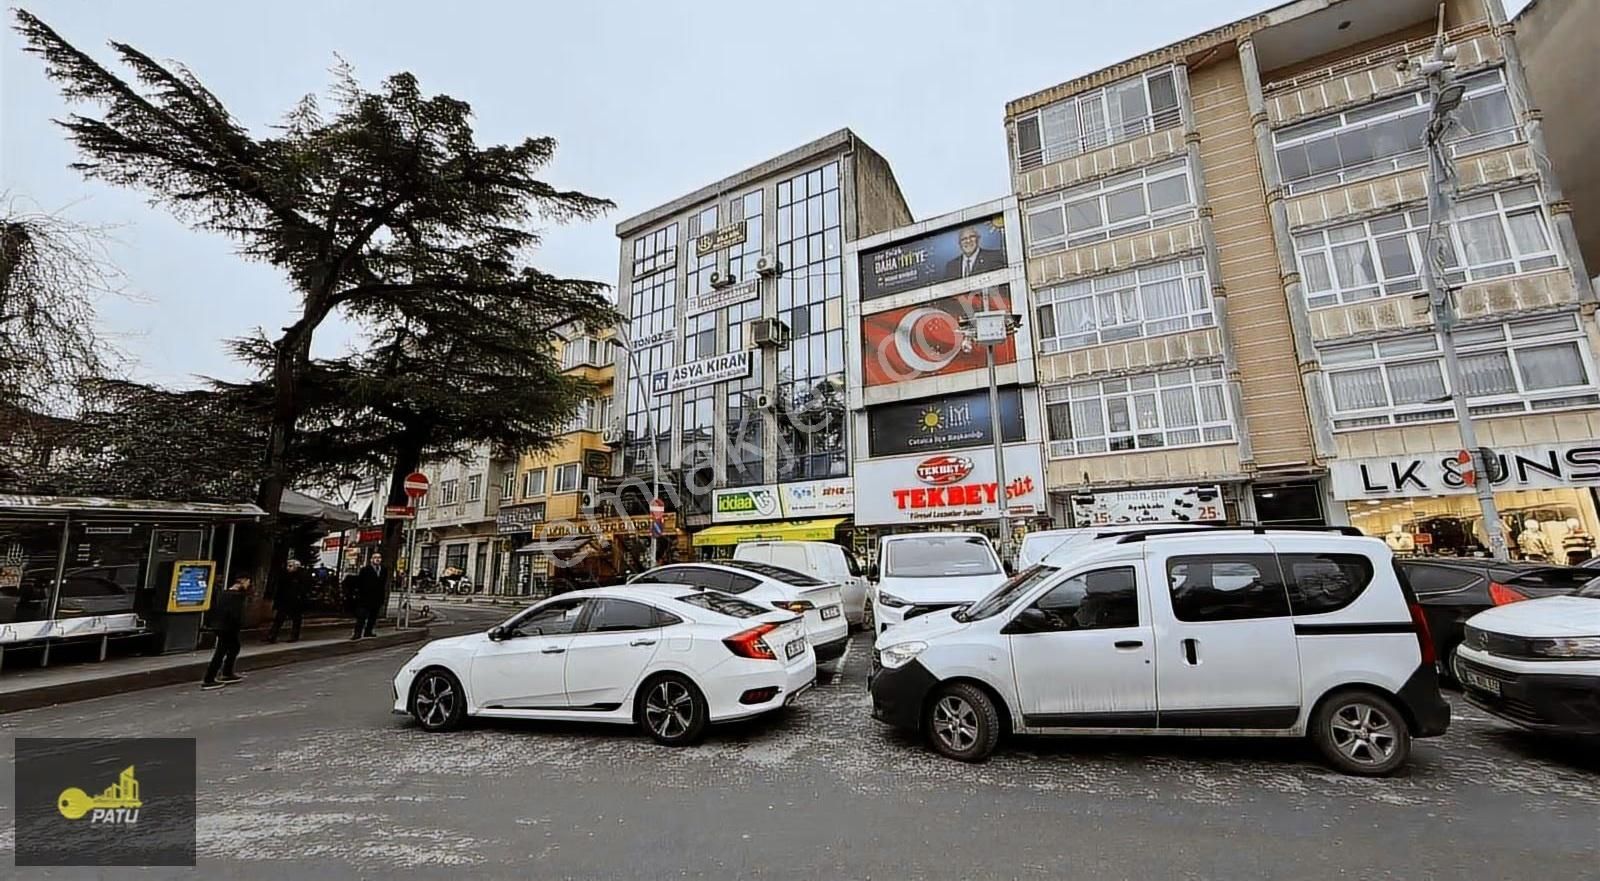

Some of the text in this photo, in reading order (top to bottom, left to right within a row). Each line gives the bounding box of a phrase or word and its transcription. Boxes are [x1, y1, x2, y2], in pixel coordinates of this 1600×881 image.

[673, 365, 703, 382] ASYA
[707, 353, 746, 373] KIRAN
[918, 464, 960, 476] TEKBEY
[1360, 459, 1428, 492] LK
[718, 494, 751, 512] iddaa
[893, 475, 1034, 509] TEKBEY süt
[1199, 507, 1217, 519] 25
